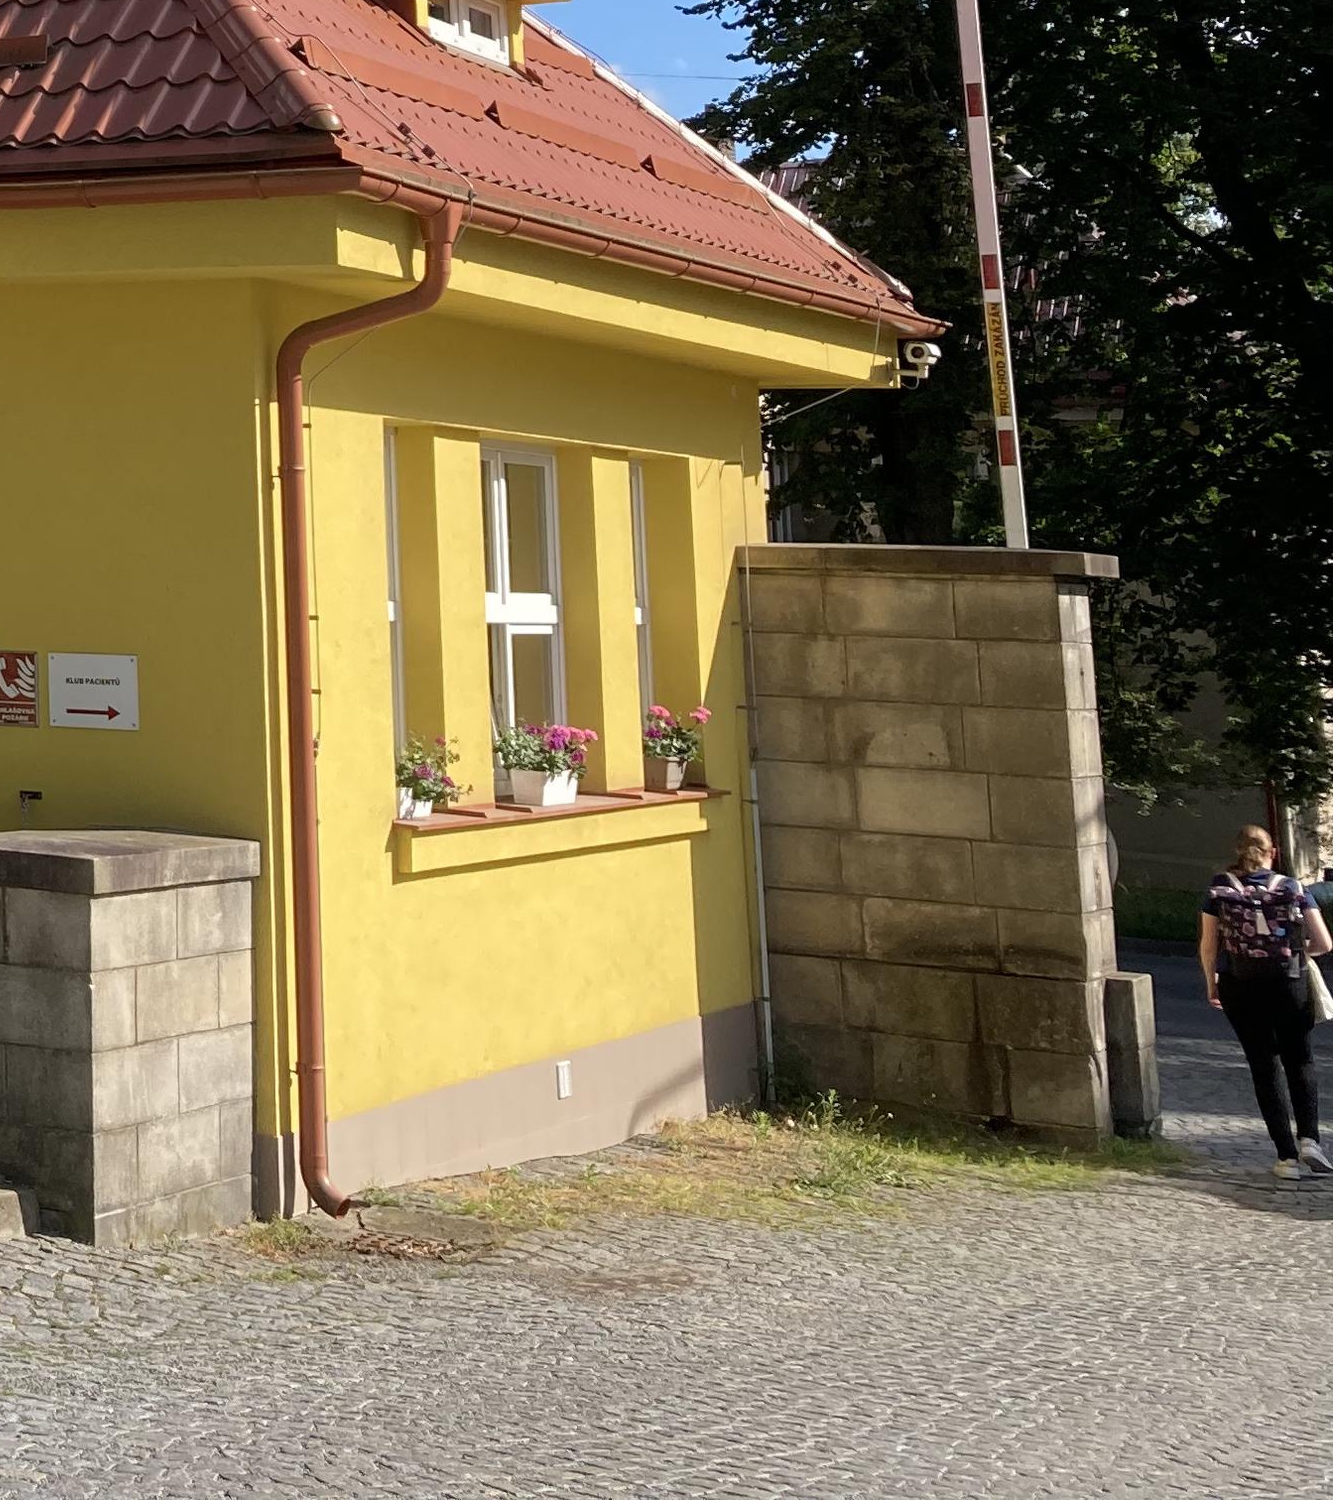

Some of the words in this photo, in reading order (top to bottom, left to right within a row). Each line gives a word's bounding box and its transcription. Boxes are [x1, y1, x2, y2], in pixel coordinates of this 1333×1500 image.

[987, 302, 1005, 357] ZAKÁZÁN
[995, 360, 1011, 417] PRŮCHOD
[65, 677, 84, 685] KLUB
